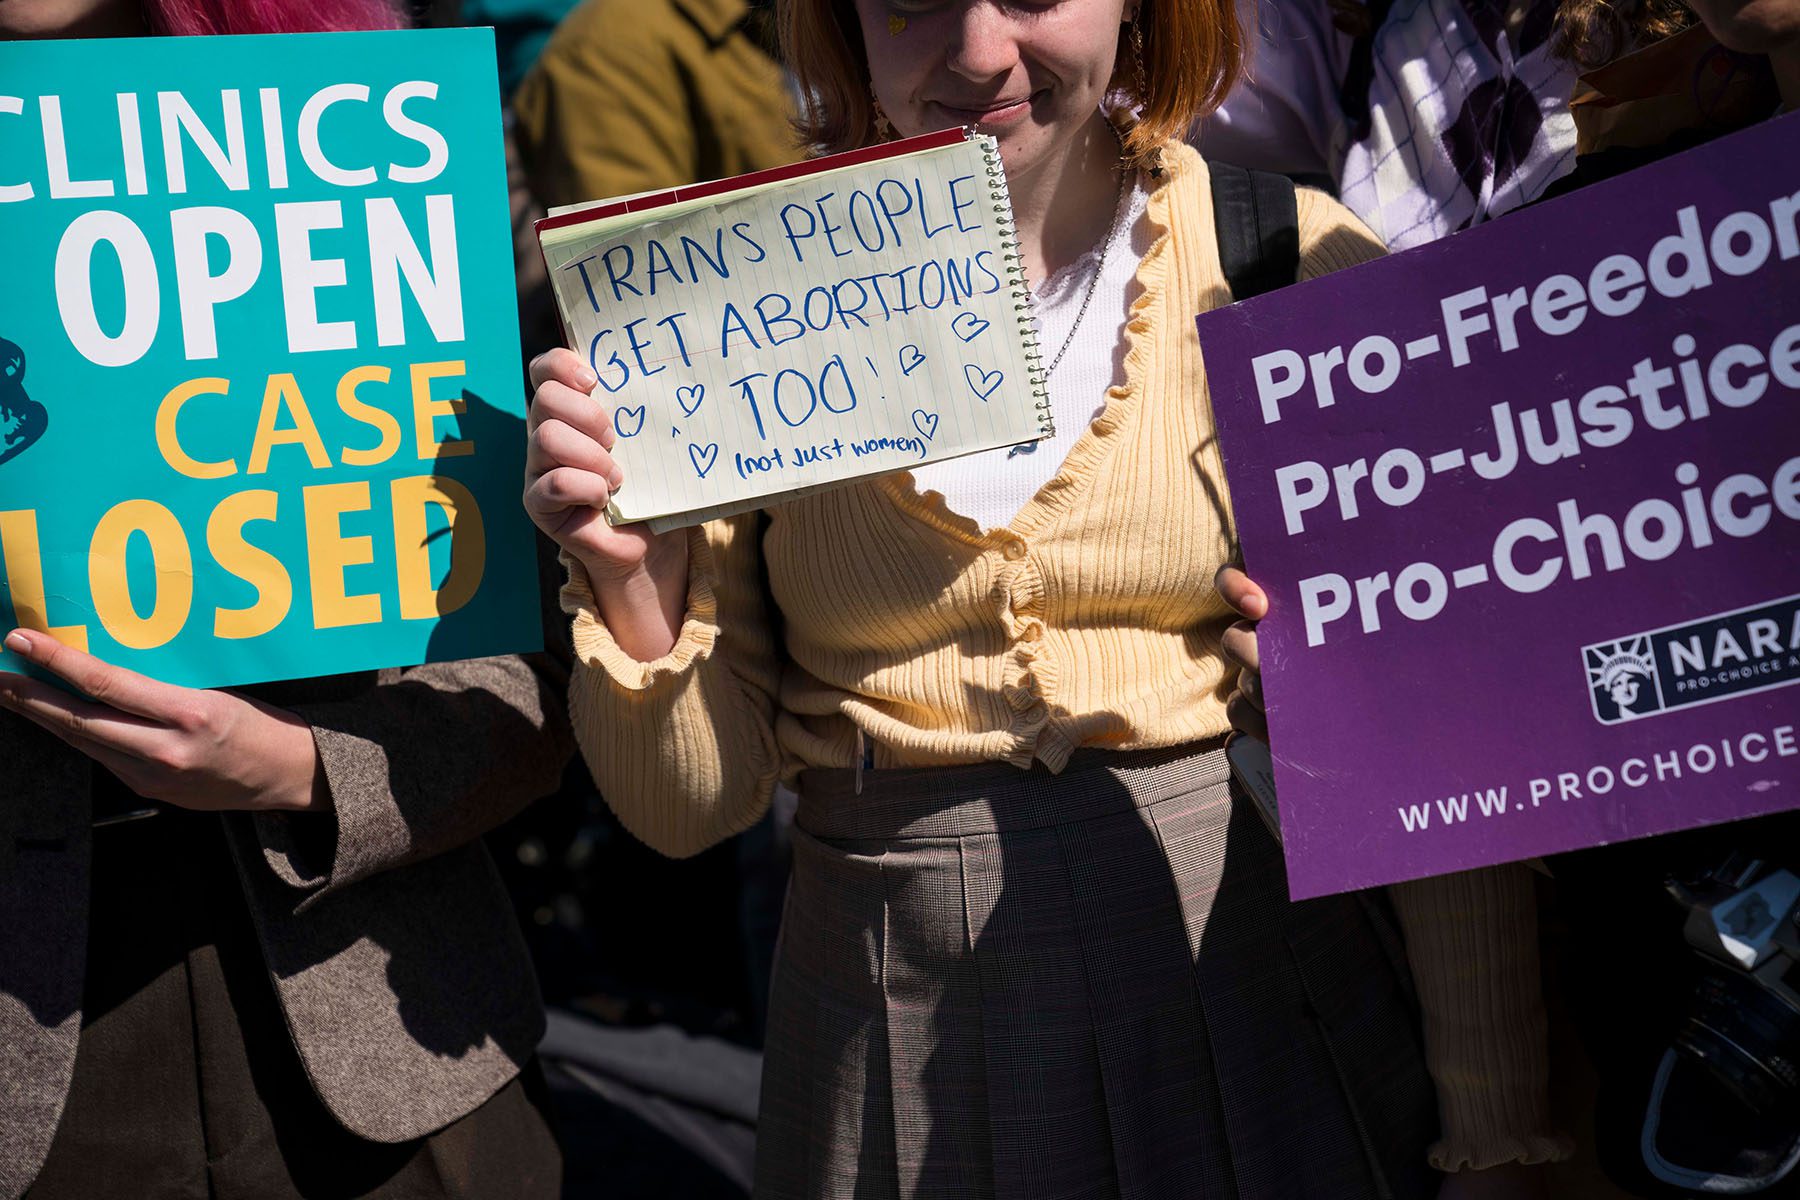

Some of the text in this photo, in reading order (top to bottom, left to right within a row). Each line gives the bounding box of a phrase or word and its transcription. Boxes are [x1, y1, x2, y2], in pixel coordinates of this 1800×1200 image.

[54, 194, 465, 367] OPEN
[565, 174, 982, 314] TRANS PEOPLE
[589, 250, 1001, 393] GET ABORTIONS
[155, 360, 474, 479] CASE
[735, 447, 784, 480] (not
[850, 436, 927, 459] women)
[0, 475, 486, 653] LOSED
[1668, 608, 1800, 677] NAR
[1676, 658, 1781, 693] PRO-CHOICE
